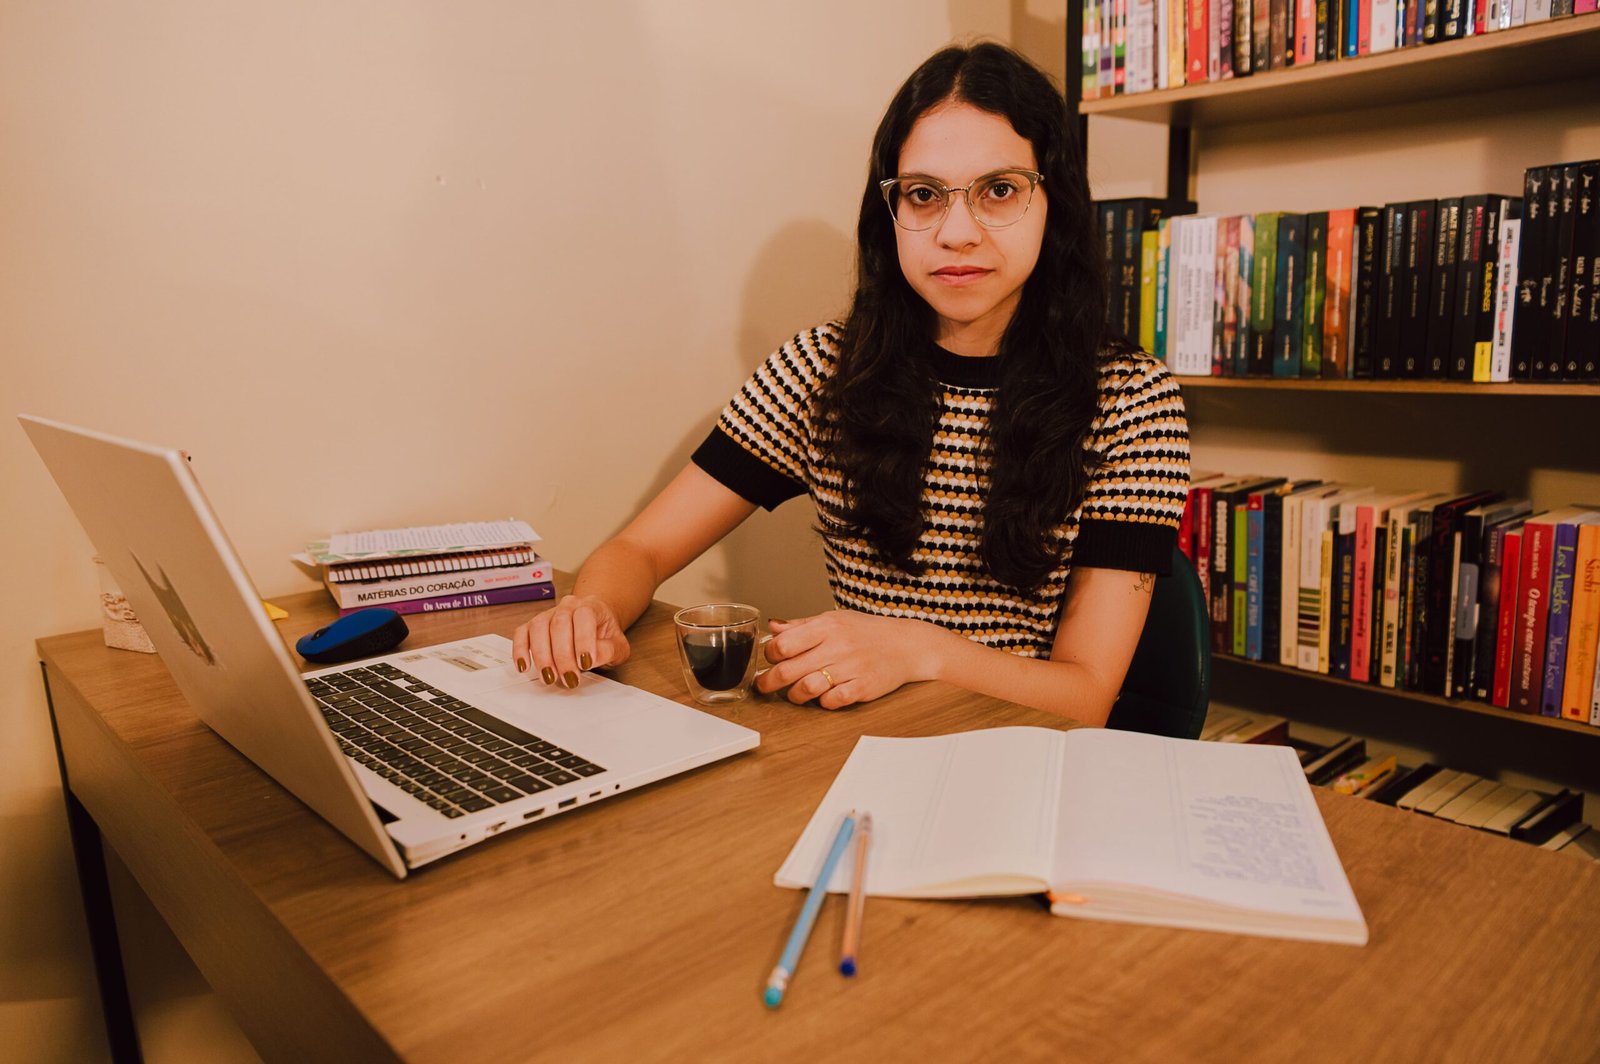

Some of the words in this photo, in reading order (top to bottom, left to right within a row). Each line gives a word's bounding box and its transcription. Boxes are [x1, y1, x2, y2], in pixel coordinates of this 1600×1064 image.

[1557, 545, 1574, 567] Los
[1583, 558, 1600, 593] Sushi
[357, 585, 408, 603] MATÉRIAS
[409, 585, 424, 595] DO
[426, 578, 476, 592] CORAÇÃO
[1552, 569, 1572, 615] Angeles
[423, 602, 433, 612] Os
[433, 600, 451, 610] Ares
[452, 599, 462, 608] de
[462, 595, 489, 606] LUISA
